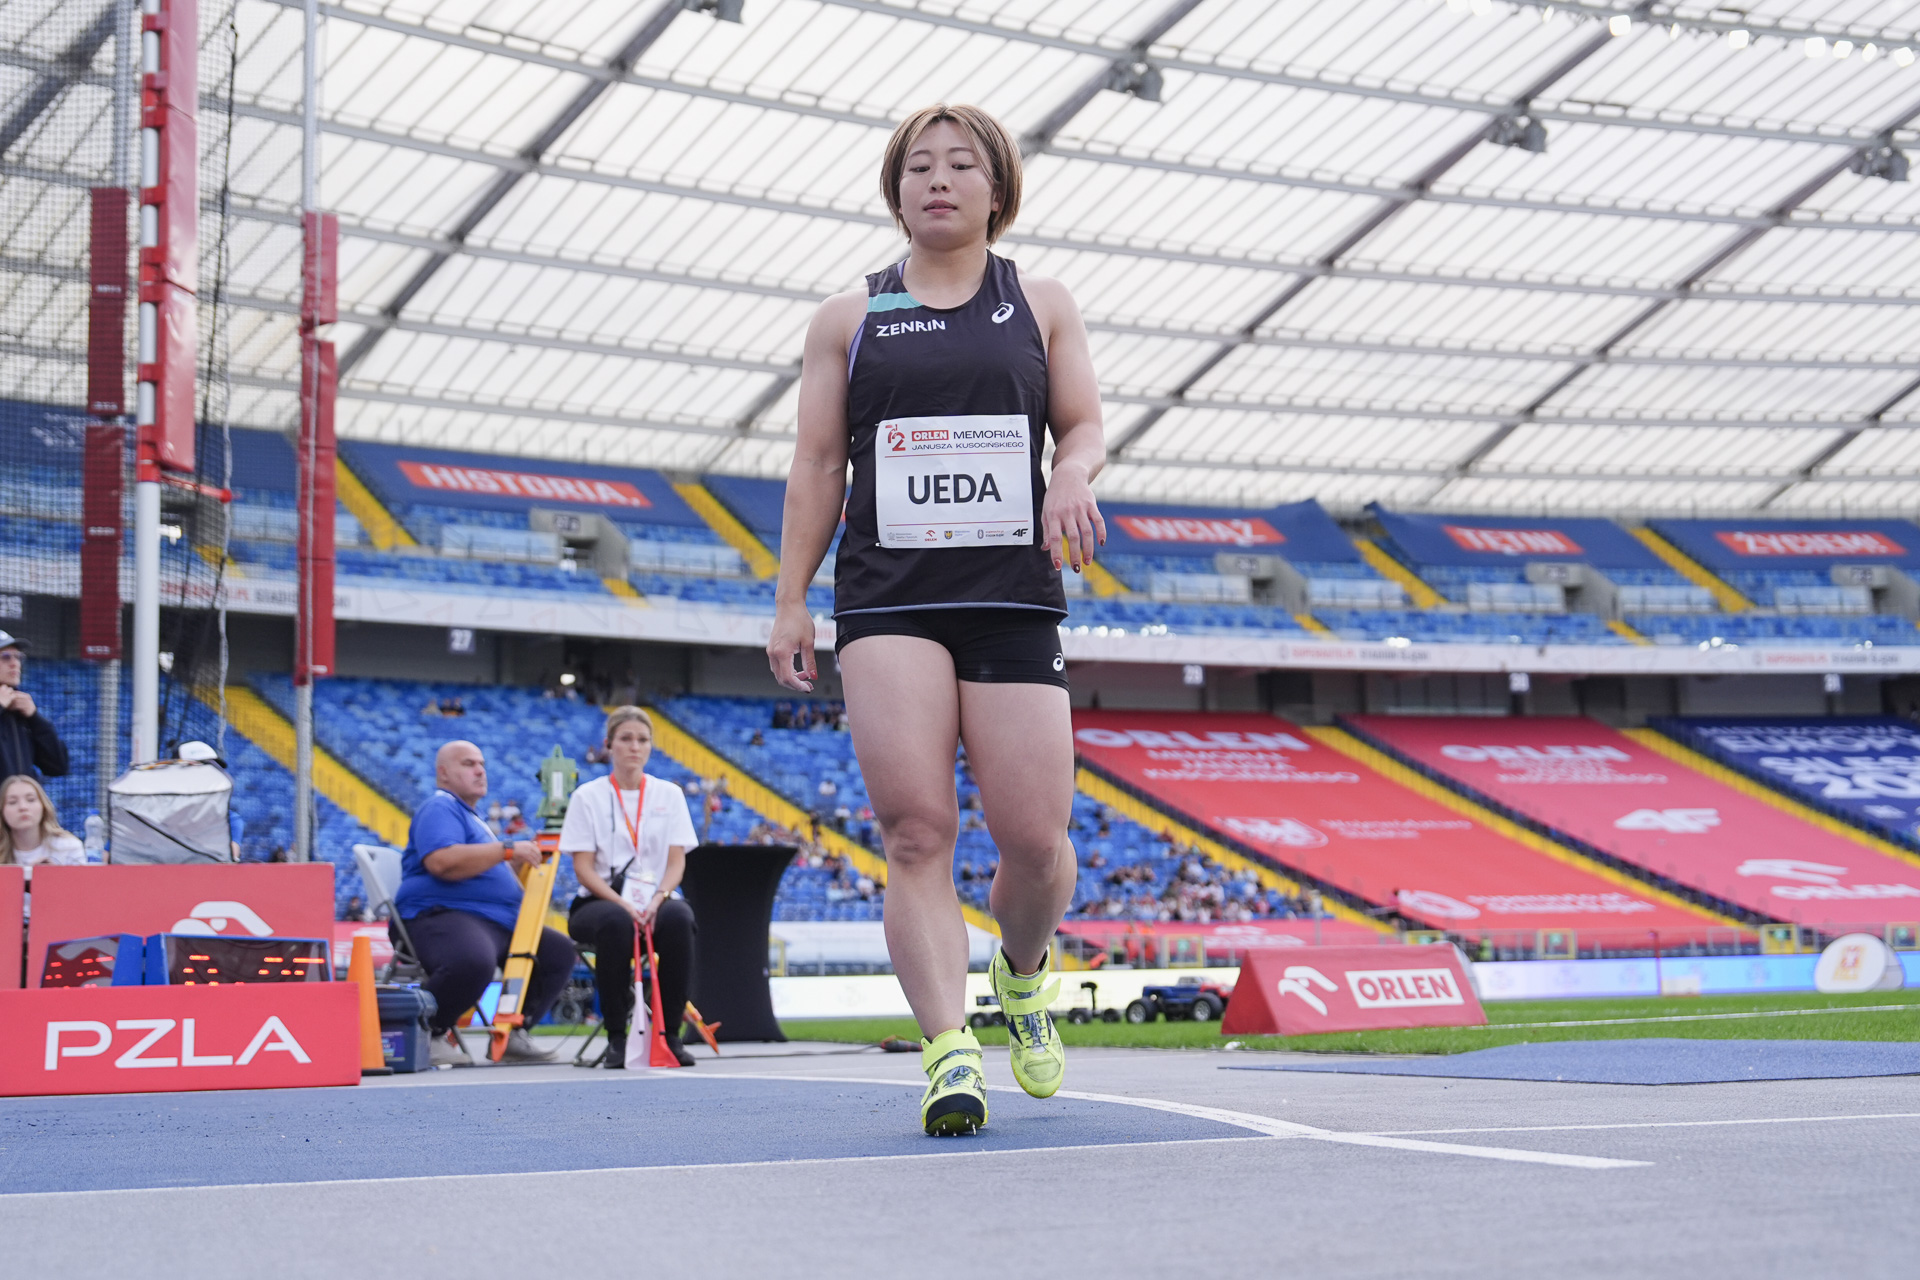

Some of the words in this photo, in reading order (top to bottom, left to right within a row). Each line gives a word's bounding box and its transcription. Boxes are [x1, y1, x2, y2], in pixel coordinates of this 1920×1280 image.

[876, 319, 946, 337] ZENRIN
[911, 443, 953, 451] JANUSZA
[955, 441, 1025, 450] KUSOCIŃSKIEGO
[913, 431, 948, 441] ORLEN
[953, 429, 1023, 439] MEMORIAŁ
[419, 464, 641, 507] HISTORIA.
[908, 473, 1003, 505] UEDA
[1012, 528, 1029, 537] 4F
[450, 629, 473, 651] 27
[1075, 727, 1311, 751] ORLEN
[1440, 744, 1633, 763] ORLEN
[1356, 974, 1455, 1001] ORLEN
[44, 1015, 312, 1071] PZLA
